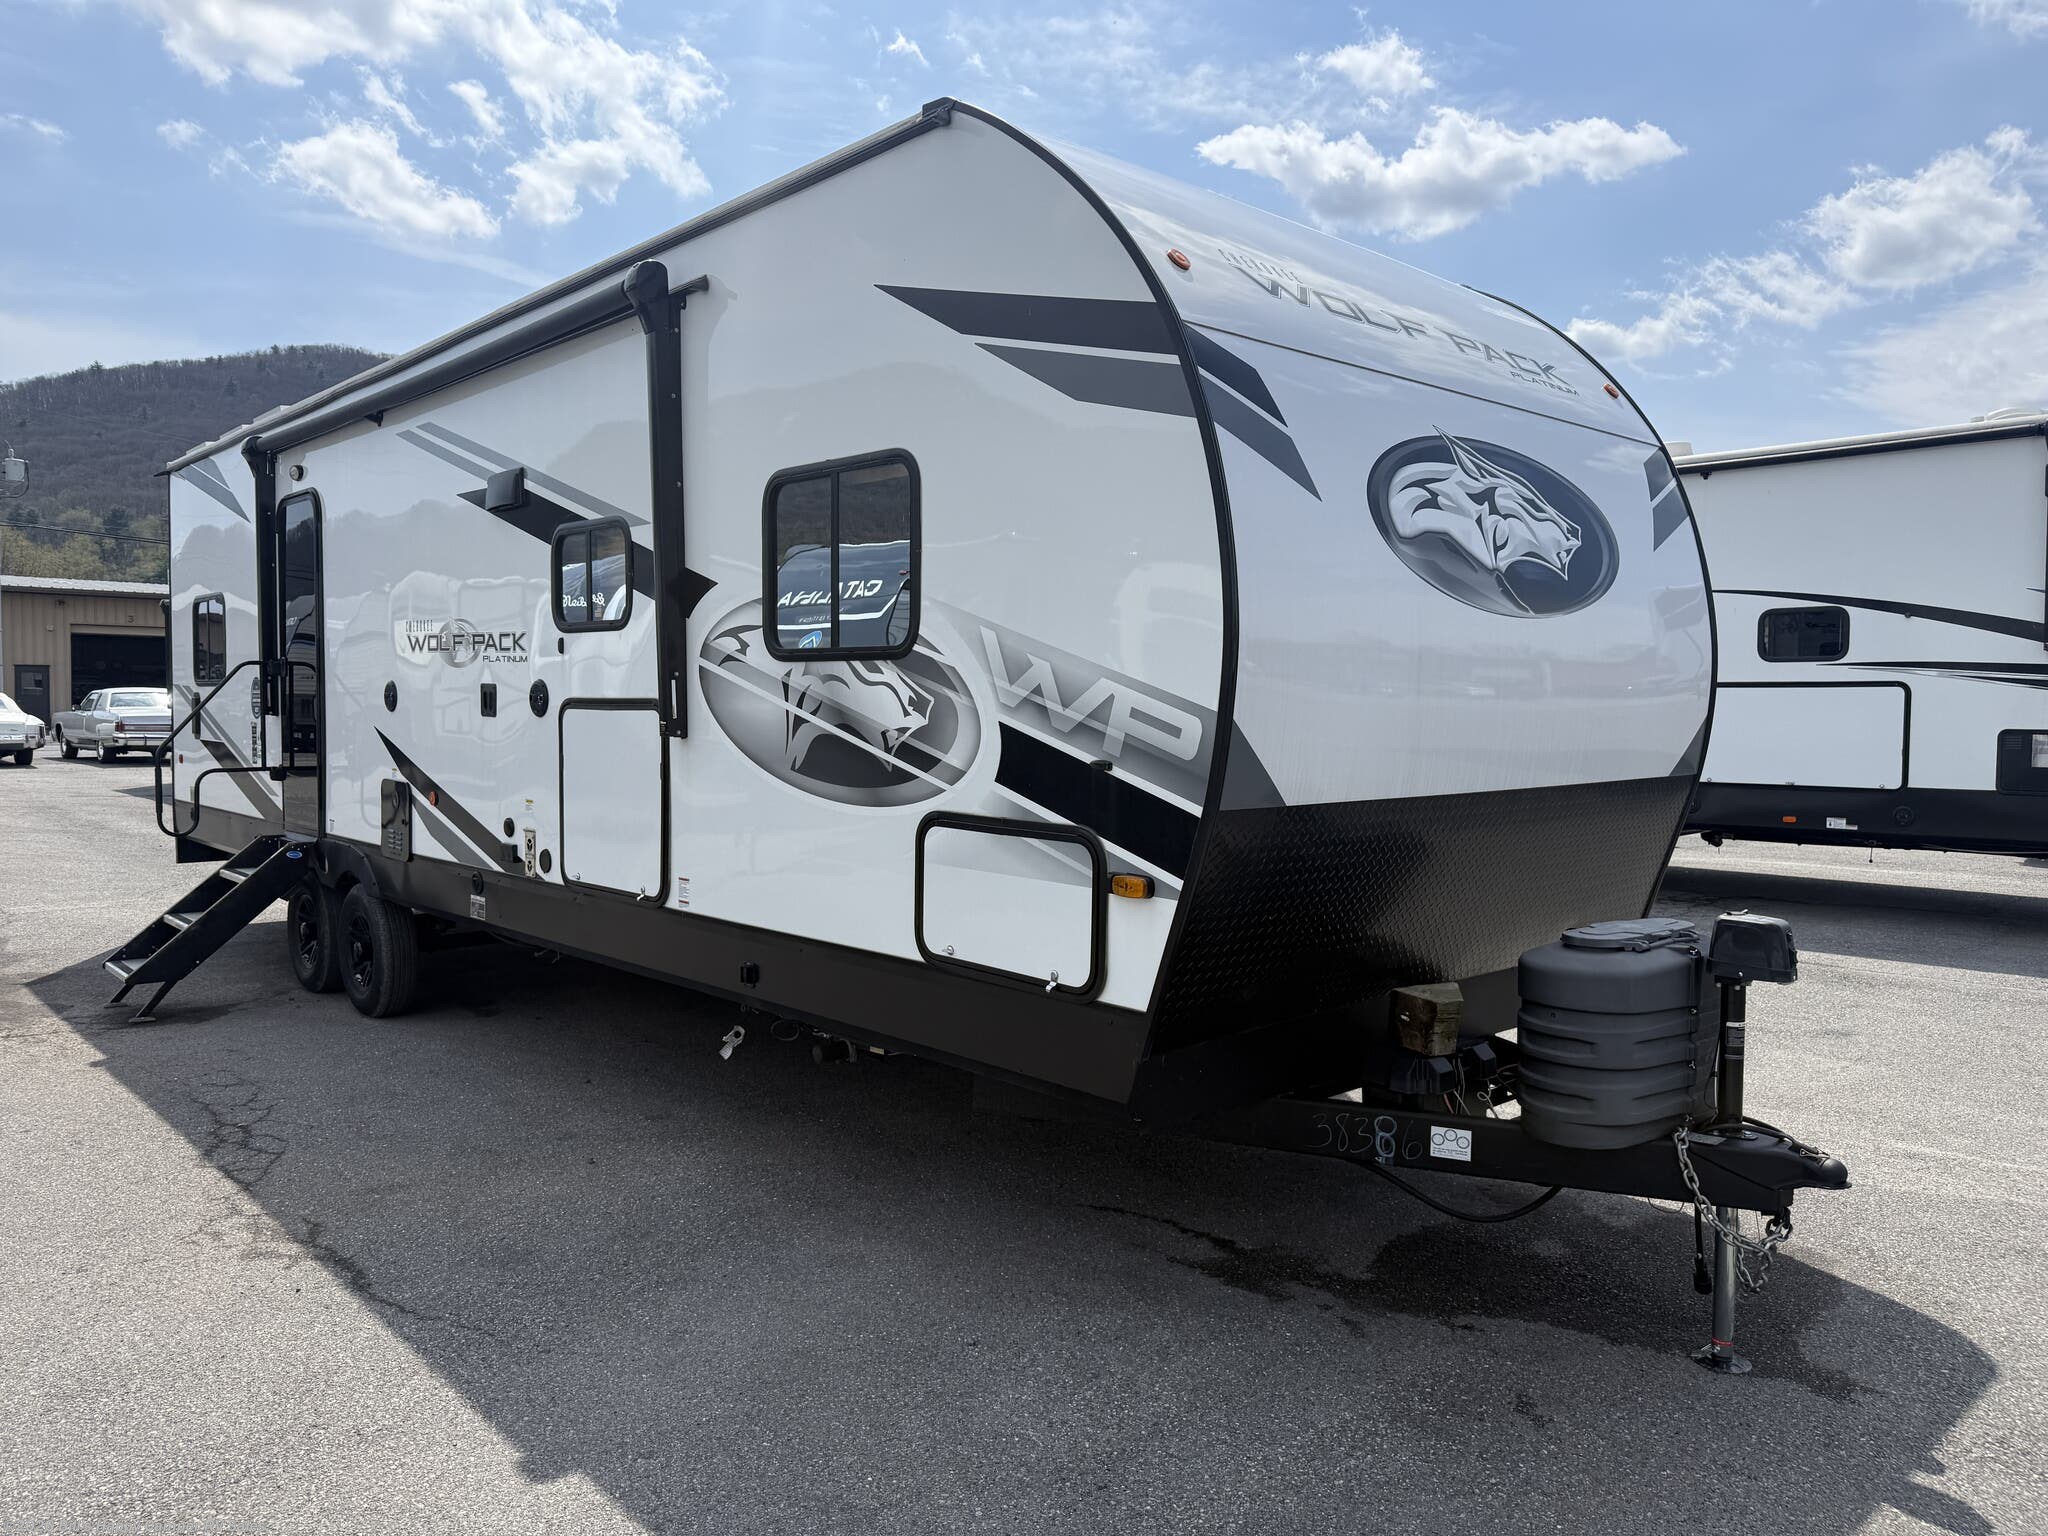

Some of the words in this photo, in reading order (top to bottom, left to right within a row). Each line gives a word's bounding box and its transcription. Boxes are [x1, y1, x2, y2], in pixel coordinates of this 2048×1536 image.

[1228, 262, 1429, 339] WOLF
[1434, 326, 1576, 387] PACK
[1510, 370, 1581, 398] PLATINUM
[406, 633, 466, 653] WOLF
[470, 631, 527, 653] PACK
[482, 655, 528, 663] PLATINUM
[979, 624, 1203, 762] WP
